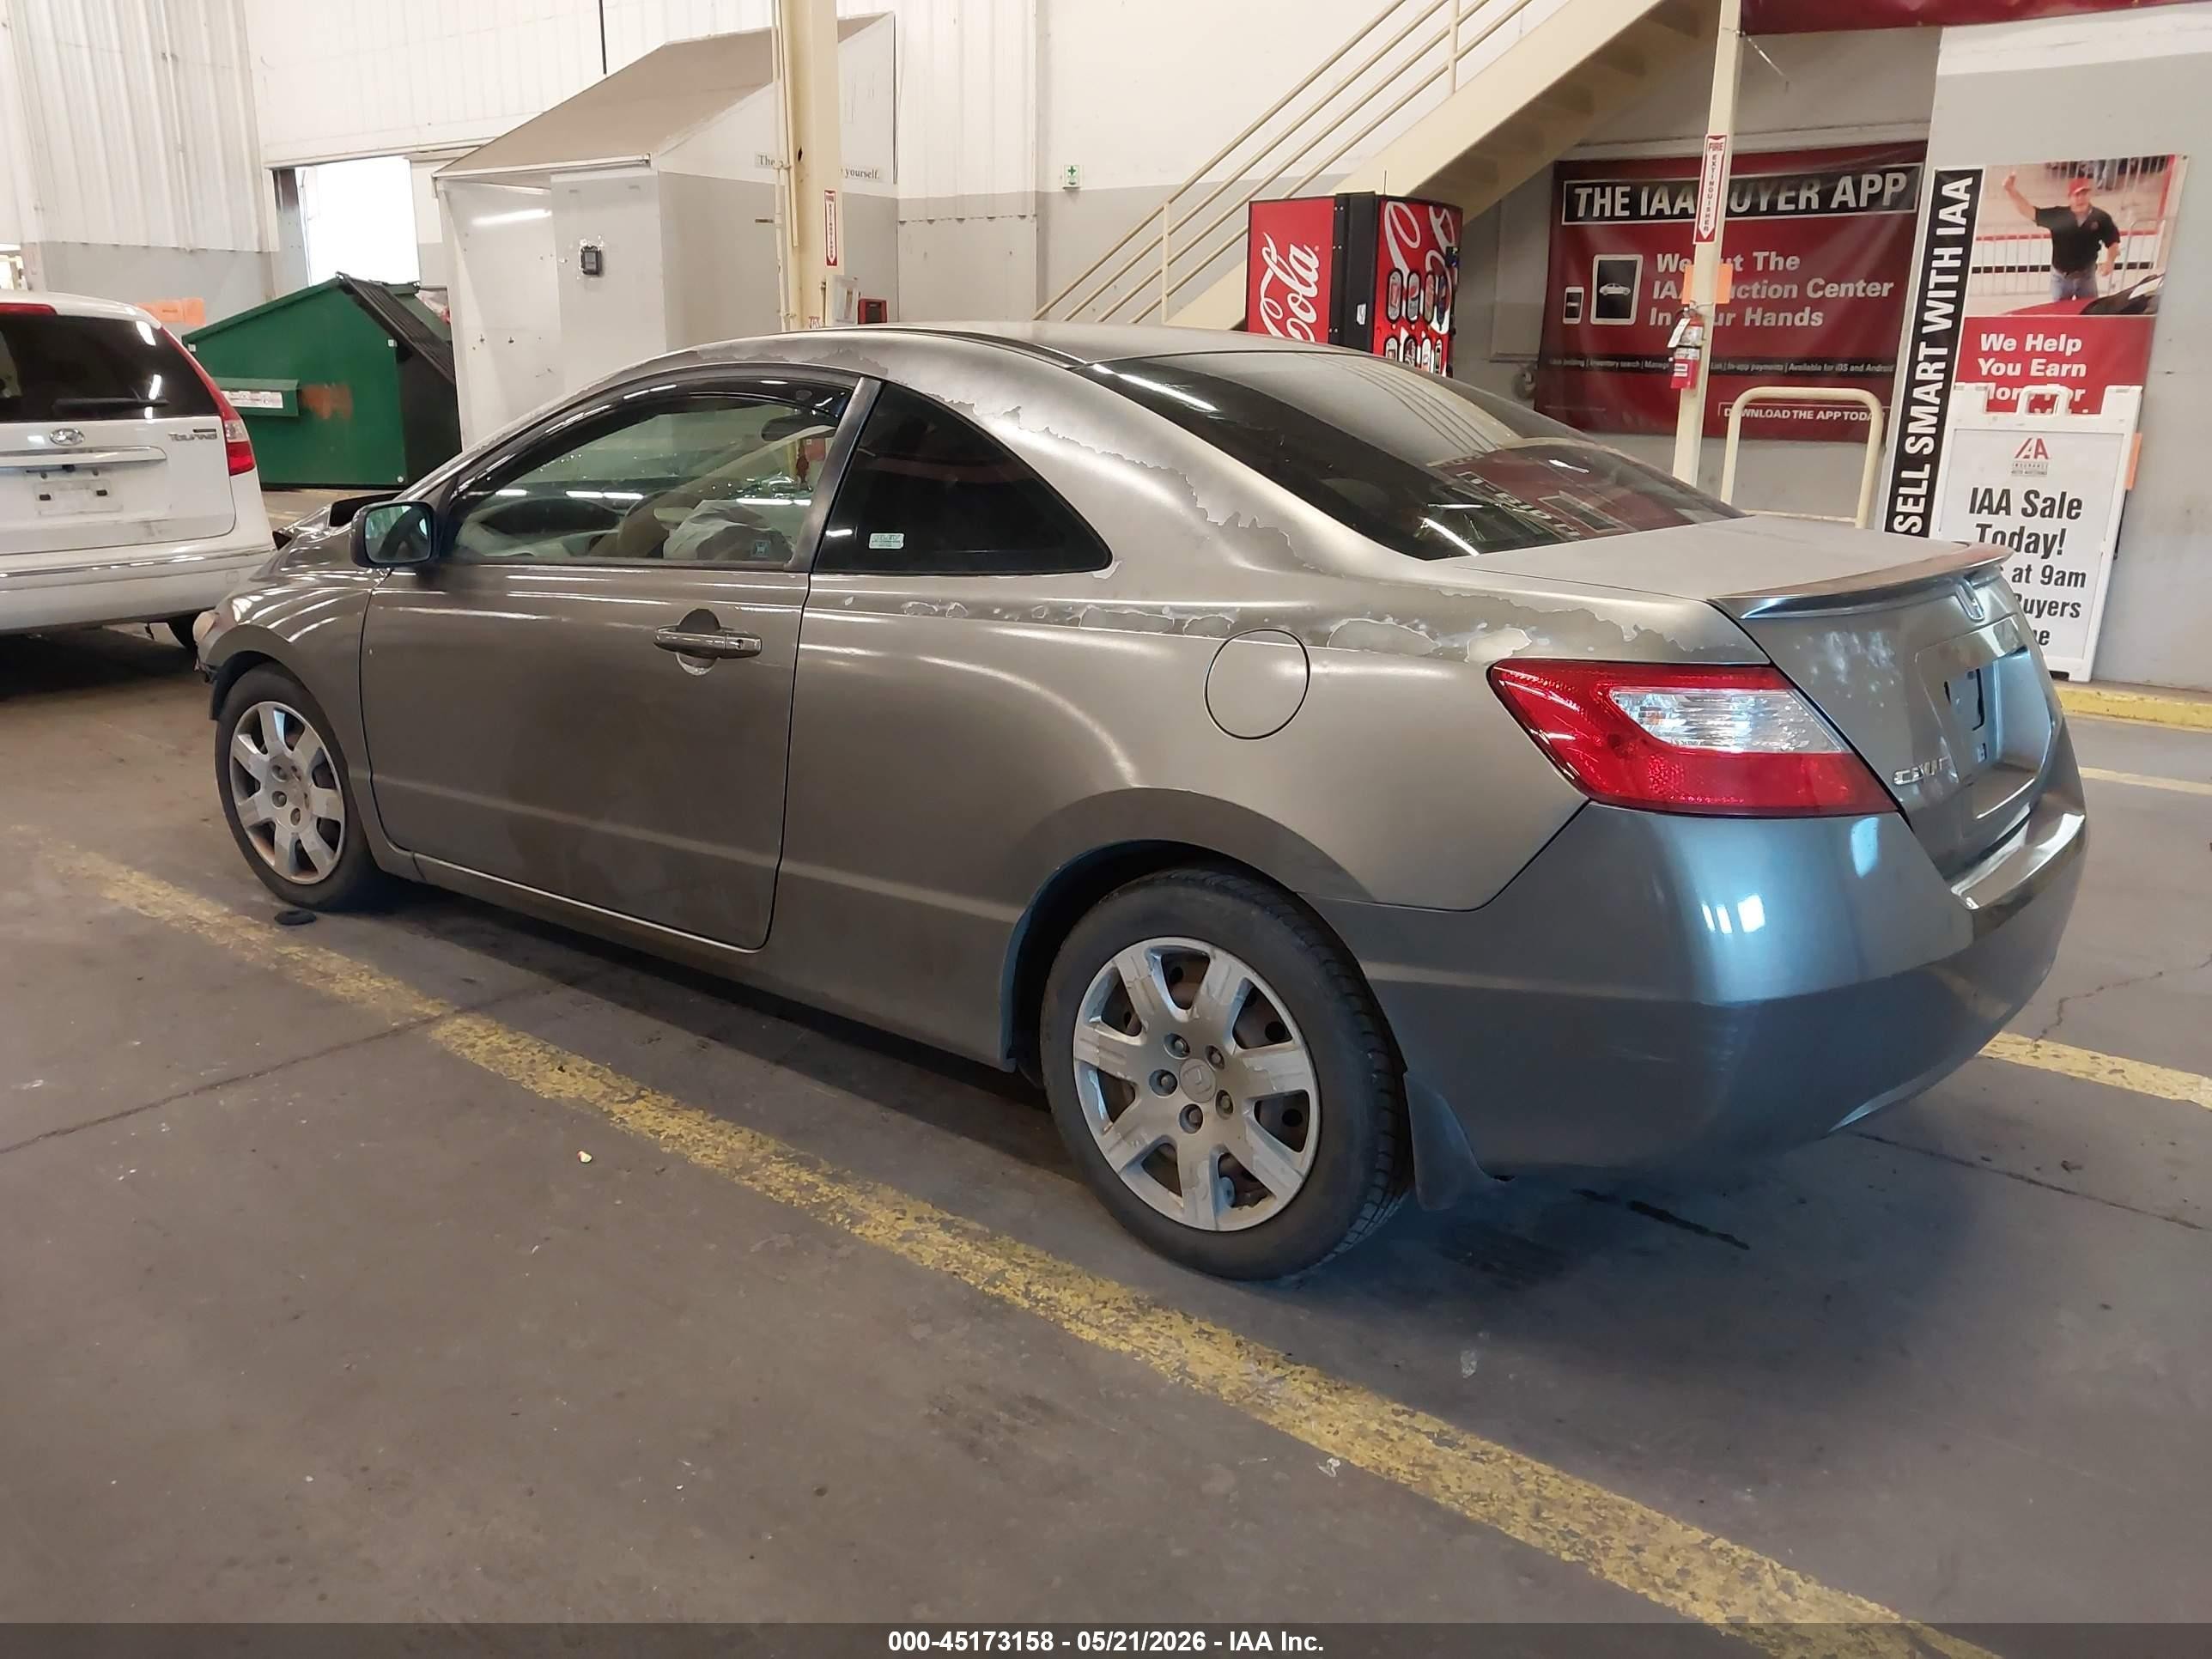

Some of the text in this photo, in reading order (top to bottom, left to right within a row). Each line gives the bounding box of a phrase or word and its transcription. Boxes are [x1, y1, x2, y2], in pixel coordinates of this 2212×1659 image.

[844, 167, 880, 179] yourself.
[1574, 172, 1907, 218] THE IAA UYER APP
[1753, 251, 1801, 271] The
[1806, 276, 1894, 298] Center
[1649, 307, 1672, 326] In
[1744, 306, 1824, 326] Hands
[1893, 176, 1973, 534] SELL SMART WITH IAA
[1980, 333, 2082, 356] We Help
[1978, 357, 2087, 377] You Earn
[1724, 408, 1790, 419] DWNLOAD
[1793, 410, 1814, 420] THE
[1816, 410, 1842, 420] APP
[1968, 487, 2083, 520] IAA Sale
[1975, 522, 2068, 560] Today!
[2011, 563, 2087, 588] at 9am
